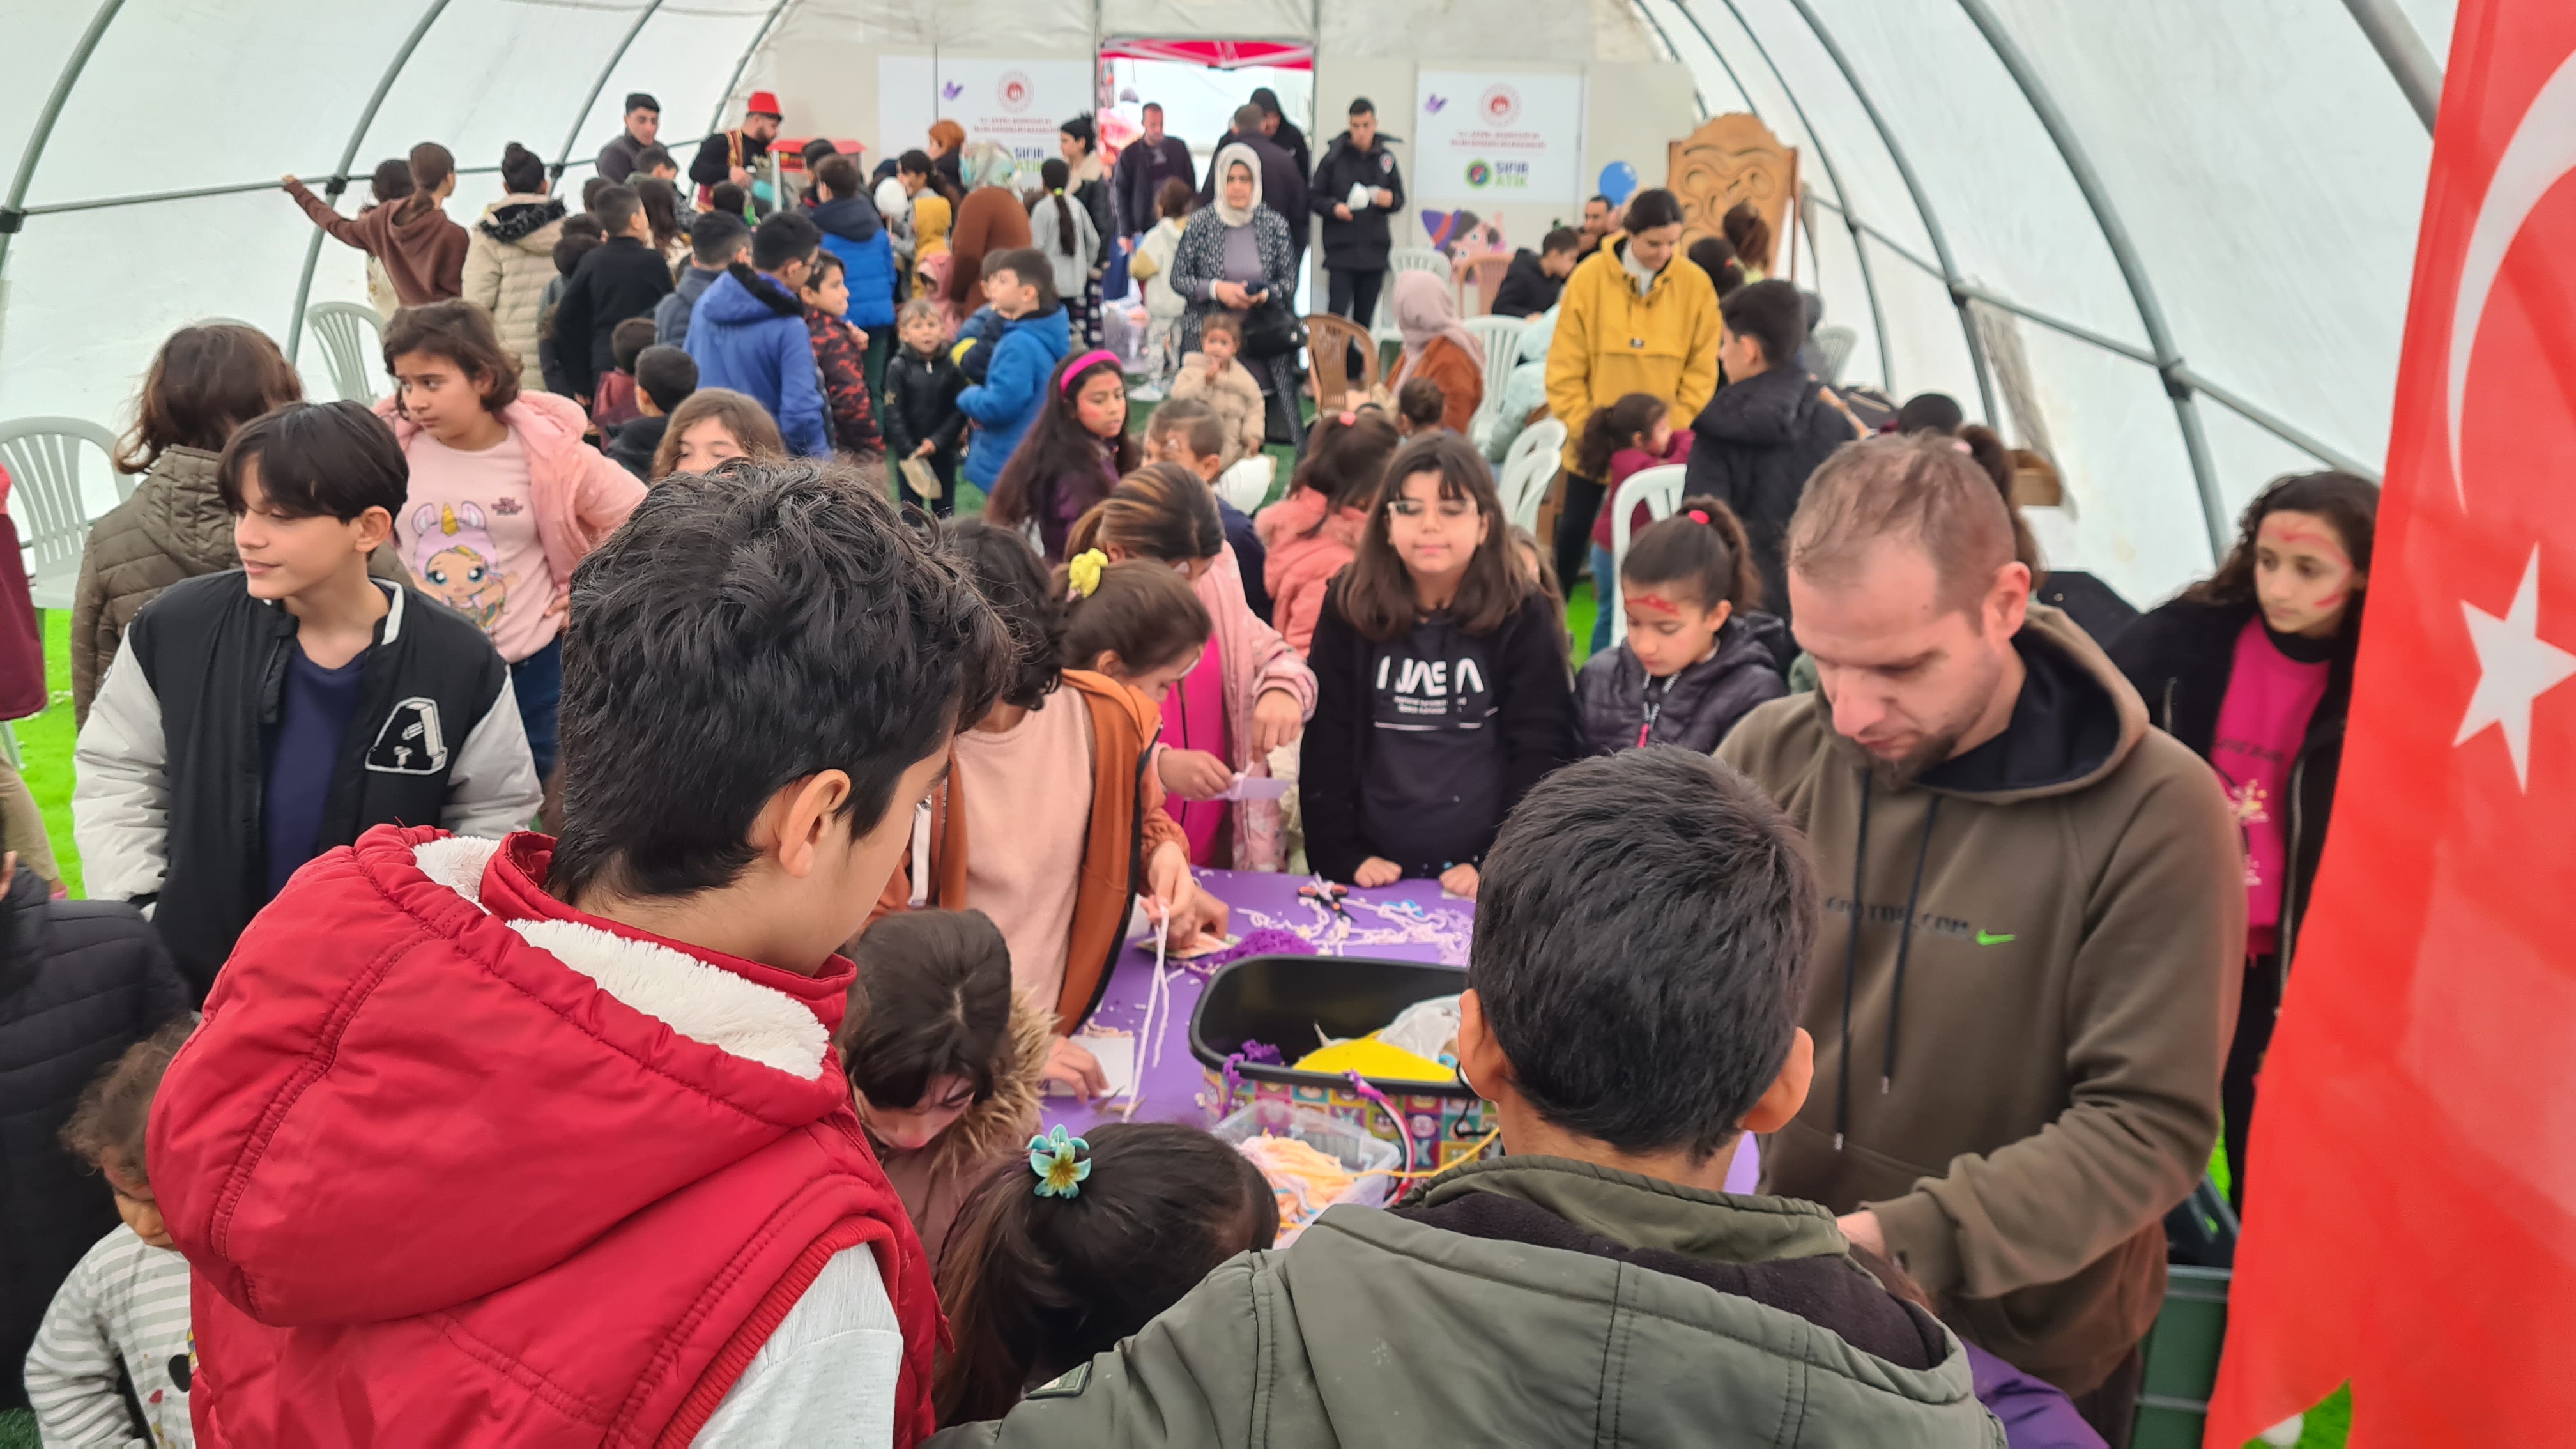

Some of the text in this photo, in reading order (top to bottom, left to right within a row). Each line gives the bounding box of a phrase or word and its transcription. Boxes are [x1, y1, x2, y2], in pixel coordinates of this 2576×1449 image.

[1496, 162, 1528, 174] SIFIR
[1496, 176, 1527, 187] ATIK
[365, 696, 448, 775] A
